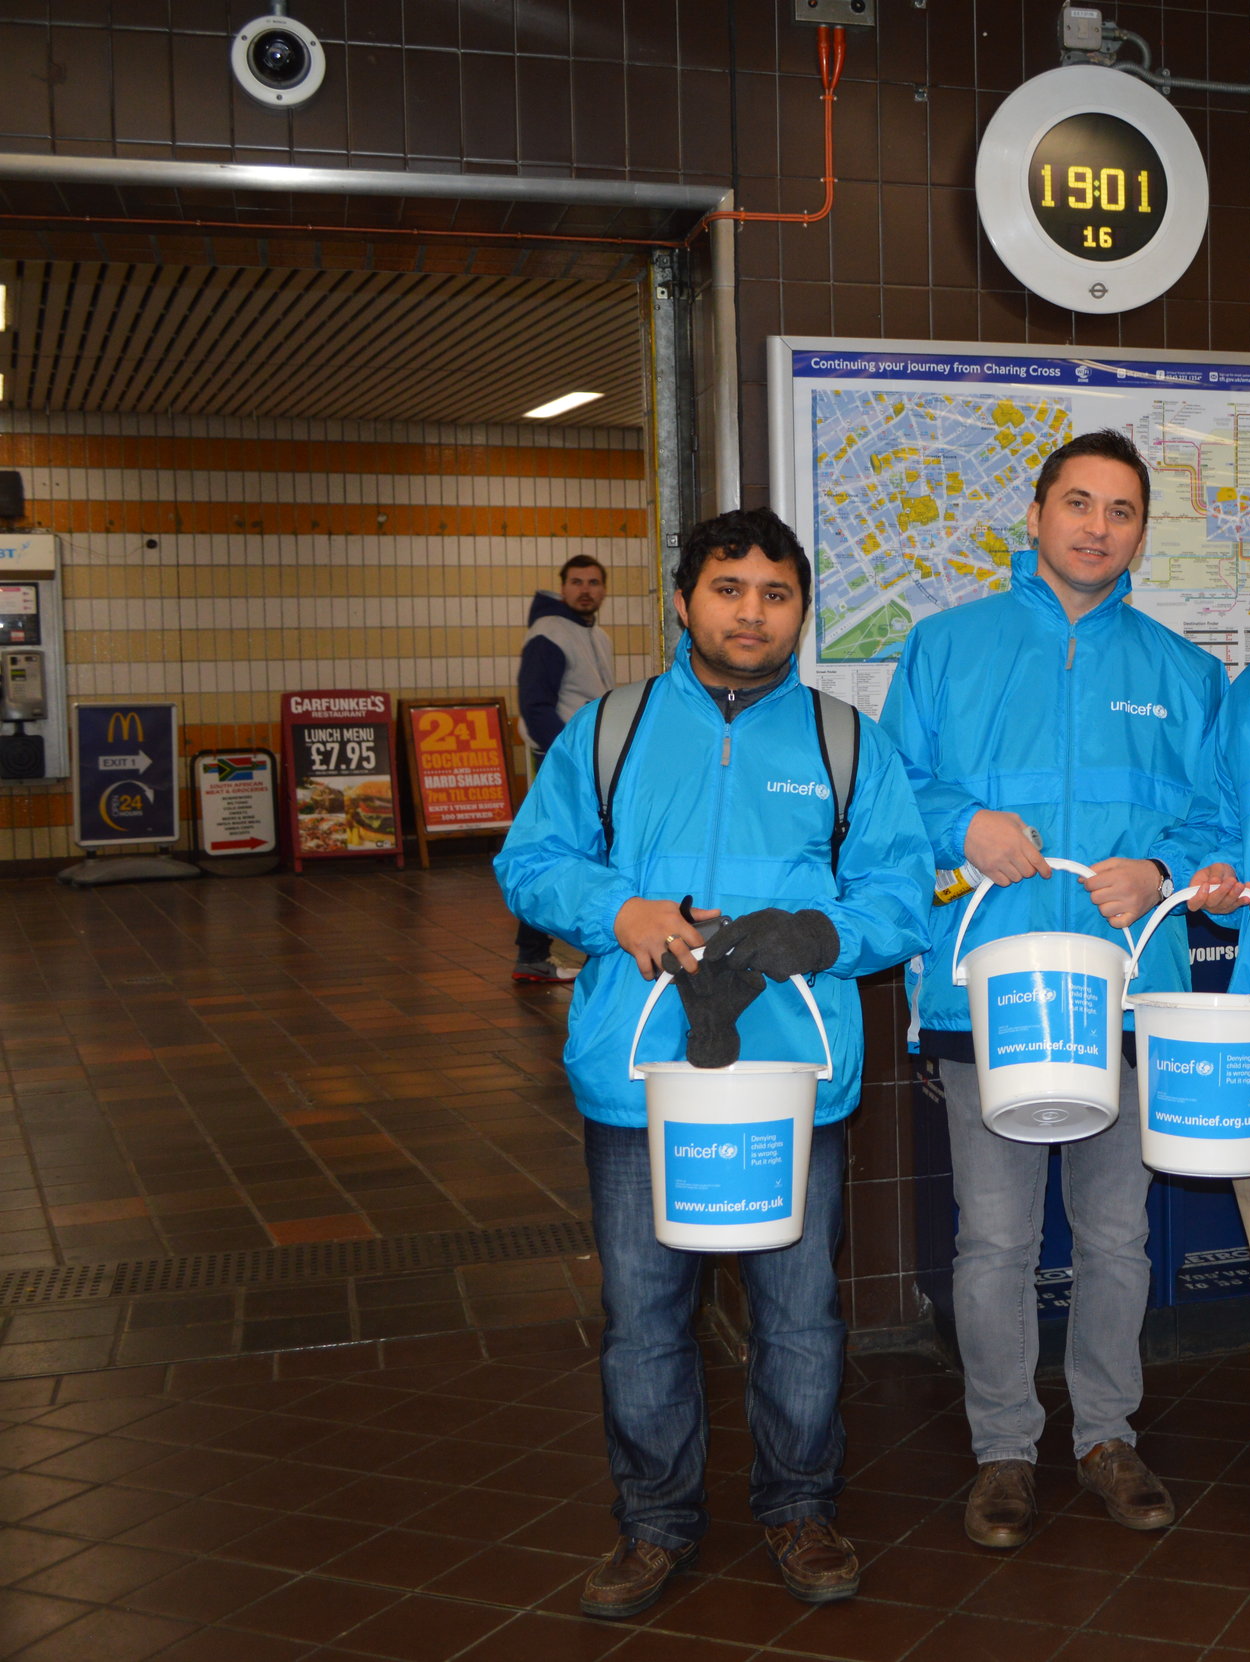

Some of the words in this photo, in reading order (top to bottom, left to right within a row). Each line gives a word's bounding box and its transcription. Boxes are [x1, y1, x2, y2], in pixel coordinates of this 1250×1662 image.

[1041, 164, 1151, 212] 19:01
[1083, 225, 1112, 248] 16
[811, 357, 876, 373] Continuing
[878, 360, 904, 374] your
[907, 361, 950, 375] journey
[953, 361, 981, 374] from
[984, 363, 1027, 377] Charing
[1029, 365, 1061, 377] Cross
[290, 695, 385, 714] GARFUNKEL'S
[1110, 700, 1152, 717] unicef
[312, 710, 366, 718] RESTAURANT
[304, 728, 340, 742] LUNCH
[344, 728, 374, 741] MENU
[103, 758, 128, 768] EXIT
[131, 758, 136, 766] 1
[311, 742, 376, 770] £7.95
[421, 750, 499, 769] COCKTAILS
[424, 774, 457, 789] HARD
[458, 772, 502, 788] SHAKES
[767, 780, 815, 796] unicef
[232, 786, 268, 794] GROCERIES
[468, 786, 504, 800] CLOSE
[119, 794, 143, 811] 24
[478, 802, 504, 810] RIGHT
[456, 812, 493, 820] METRES
[997, 989, 1039, 1006] unicef
[997, 1040, 1099, 1056] www.unicef.org.uk
[1156, 1058, 1196, 1074] unicef
[751, 1134, 776, 1142] Denying
[751, 1142, 766, 1150] child
[767, 1140, 784, 1149] rights
[674, 1144, 718, 1158] unicef
[751, 1158, 762, 1166] Put
[768, 1158, 782, 1166] right.
[674, 1196, 784, 1212] www.unicef.org.uk
[1178, 1269, 1250, 1282] You've
[1184, 1282, 1209, 1290] to
